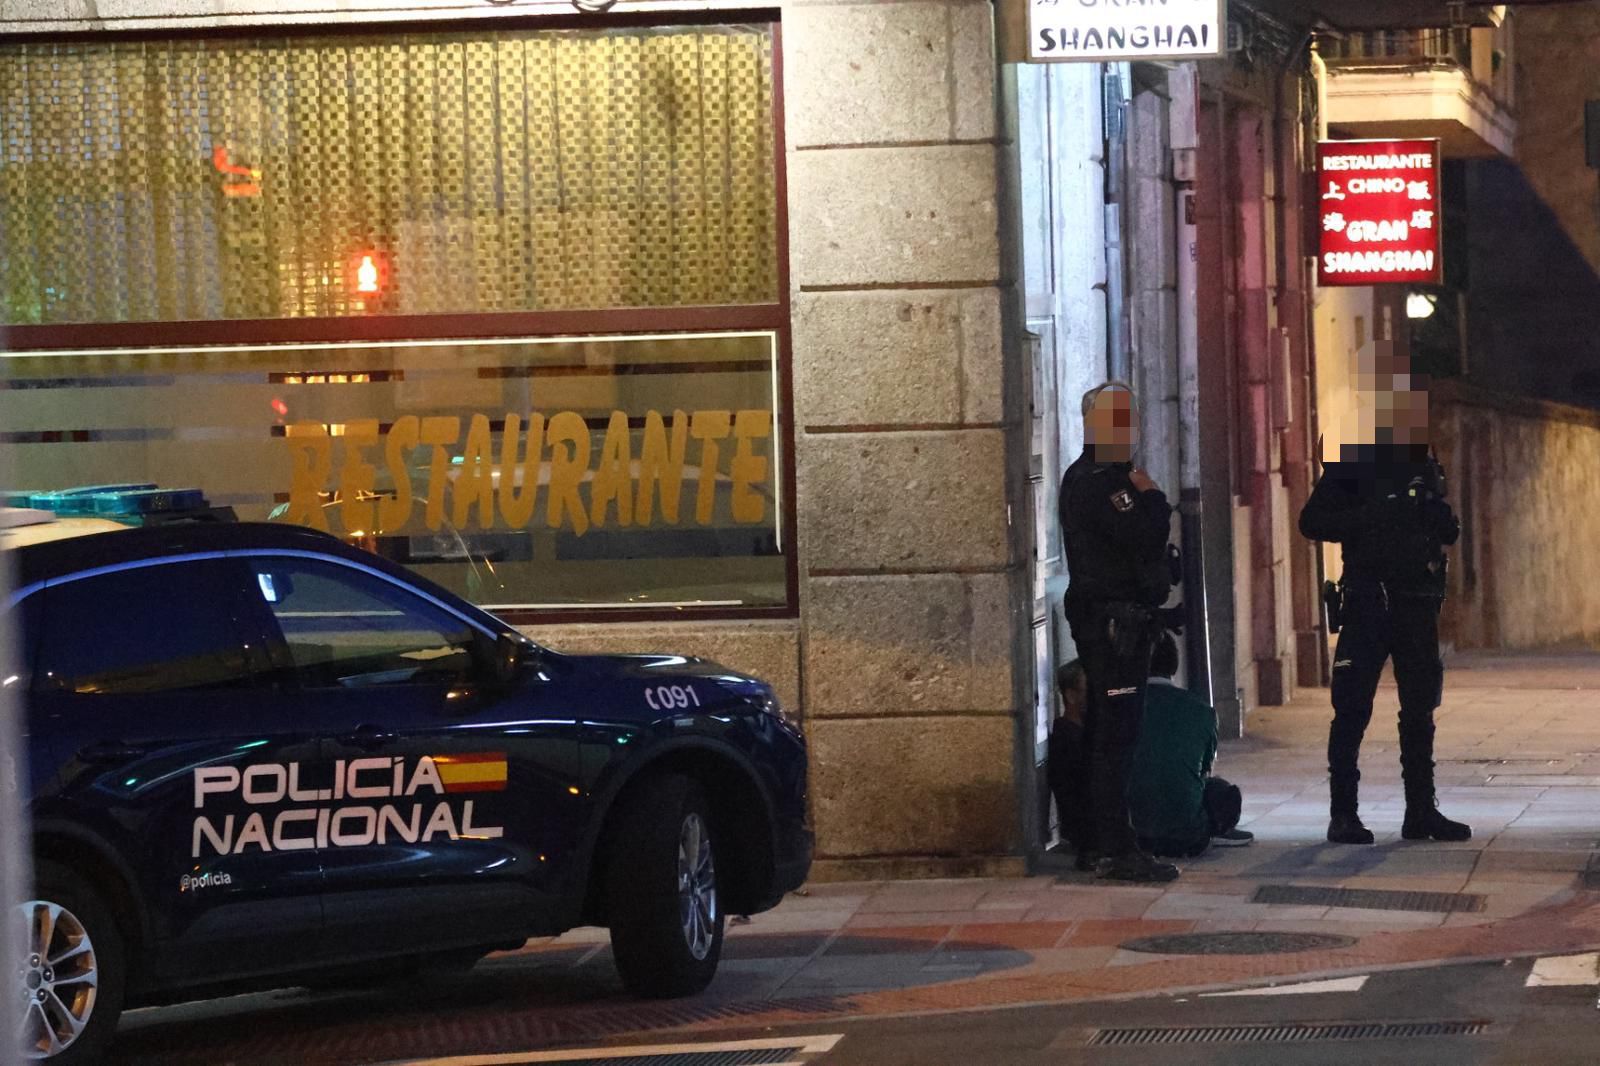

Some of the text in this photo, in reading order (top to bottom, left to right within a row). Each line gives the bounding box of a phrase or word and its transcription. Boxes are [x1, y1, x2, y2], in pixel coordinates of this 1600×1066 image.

[1039, 24, 1208, 51] SHANGHAI
[1322, 153, 1433, 171] RESTAURANTE
[1347, 177, 1406, 194] CHINO
[1346, 219, 1409, 242] GRAN
[1323, 249, 1434, 273] SHANGHAI
[286, 409, 771, 537] RESTAURANTE
[192, 800, 505, 858] NACIONAL
